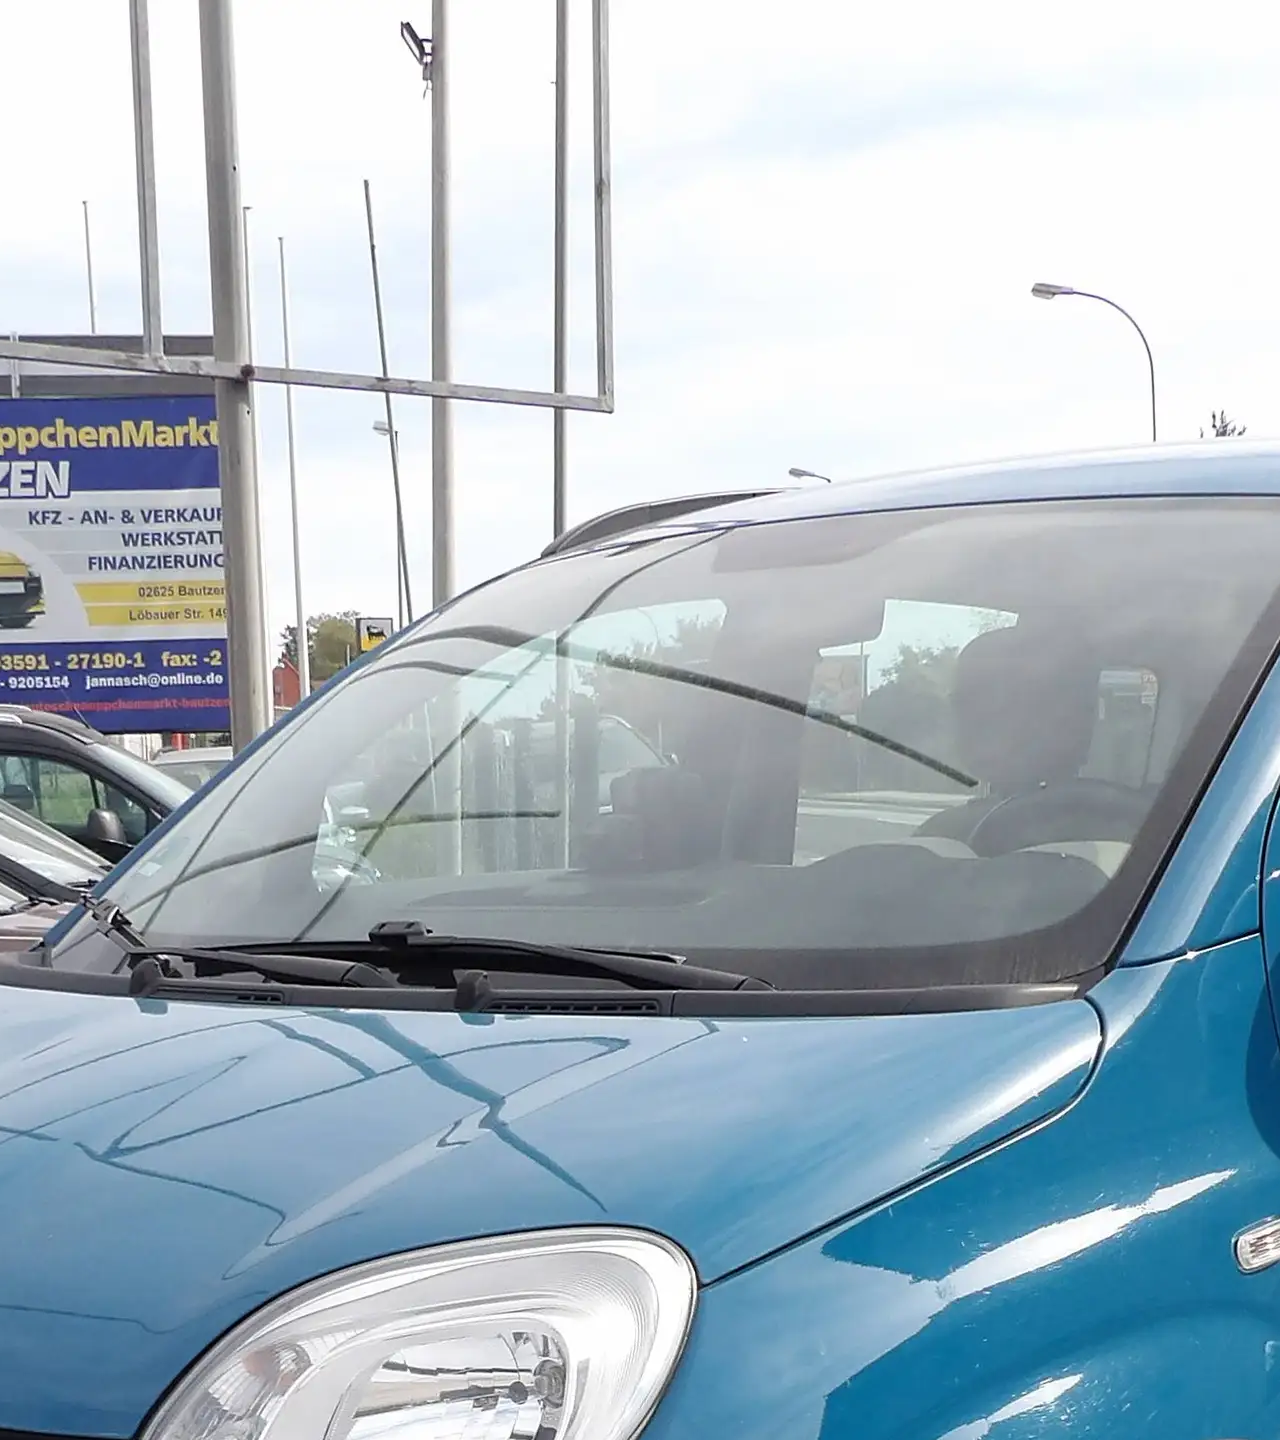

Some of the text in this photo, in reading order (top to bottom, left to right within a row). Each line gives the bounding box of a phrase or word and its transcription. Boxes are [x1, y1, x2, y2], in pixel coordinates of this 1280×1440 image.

[28, 510, 62, 525] KFZ
[80, 509, 115, 525] AN-
[121, 509, 135, 524] &
[138, 585, 175, 598] 02625
[129, 609, 180, 622] Löbauer
[183, 607, 205, 620] Str.
[67, 652, 146, 670] 27190-1
[161, 651, 198, 667] fax:
[8, 675, 70, 690] 9205154
